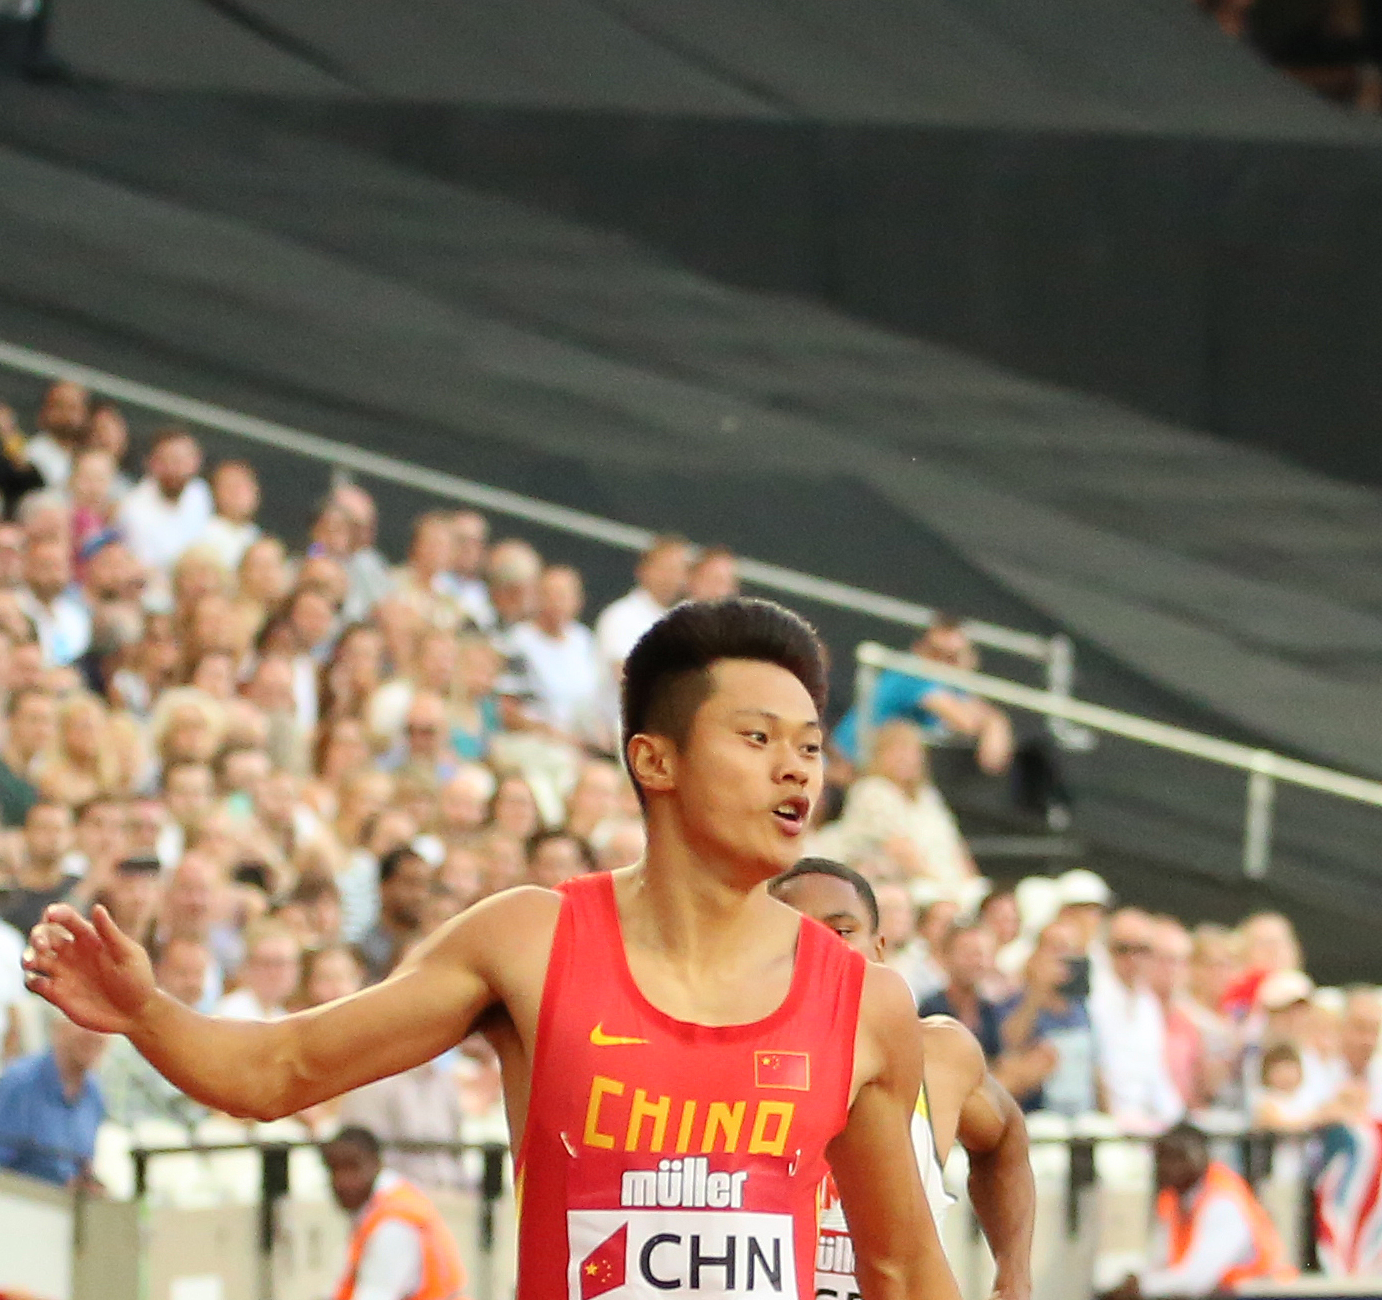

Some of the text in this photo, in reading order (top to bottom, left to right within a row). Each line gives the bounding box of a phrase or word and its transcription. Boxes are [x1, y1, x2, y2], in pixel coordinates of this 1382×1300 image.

[621, 1156, 748, 1209] müller
[639, 1232, 783, 1292] CHN
[818, 1235, 856, 1273] üll
